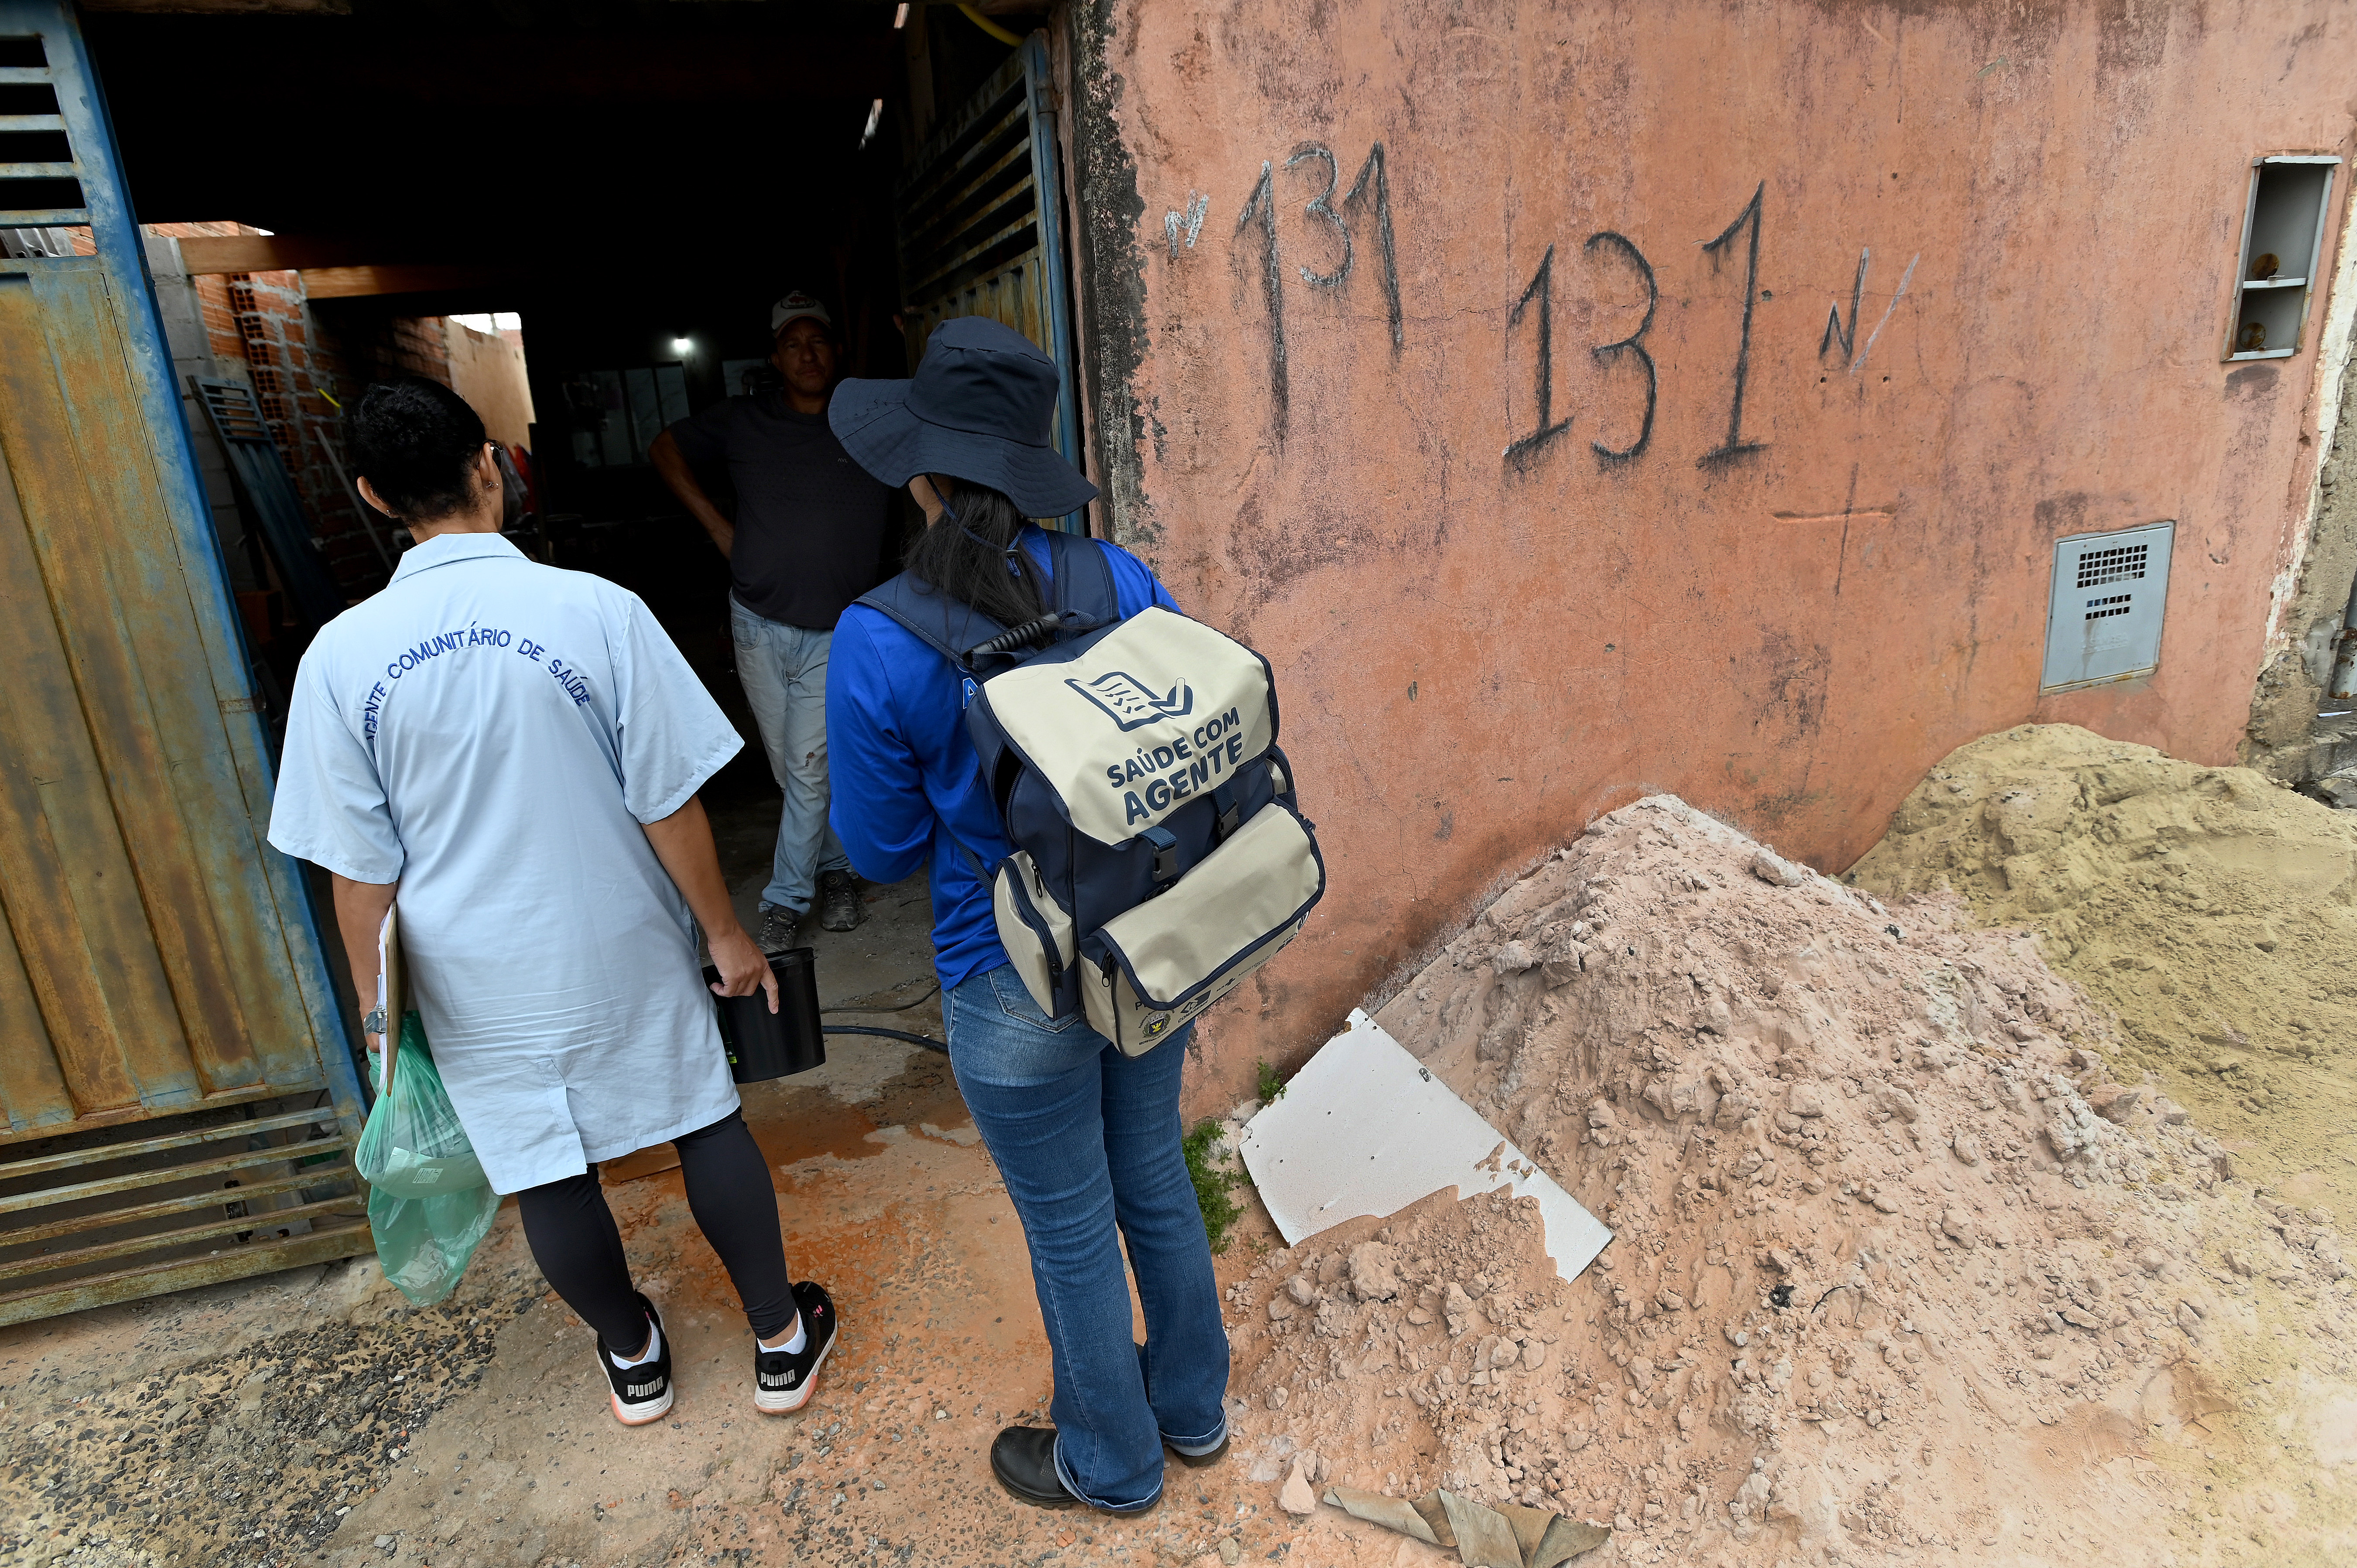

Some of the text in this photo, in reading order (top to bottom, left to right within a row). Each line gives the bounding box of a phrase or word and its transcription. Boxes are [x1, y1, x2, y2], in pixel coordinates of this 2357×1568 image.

[1234, 140, 1403, 441] 131
[1502, 180, 1768, 469] 131
[388, 621, 511, 679] COMUNITÁRIO
[517, 638, 545, 662] DE
[548, 659, 590, 707] SAÚDE
[1107, 706, 1240, 788] SAÚDE COM
[1123, 731, 1243, 826] AGENTE
[627, 1376, 663, 1397] PUMA
[760, 1369, 795, 1387] PUMA
